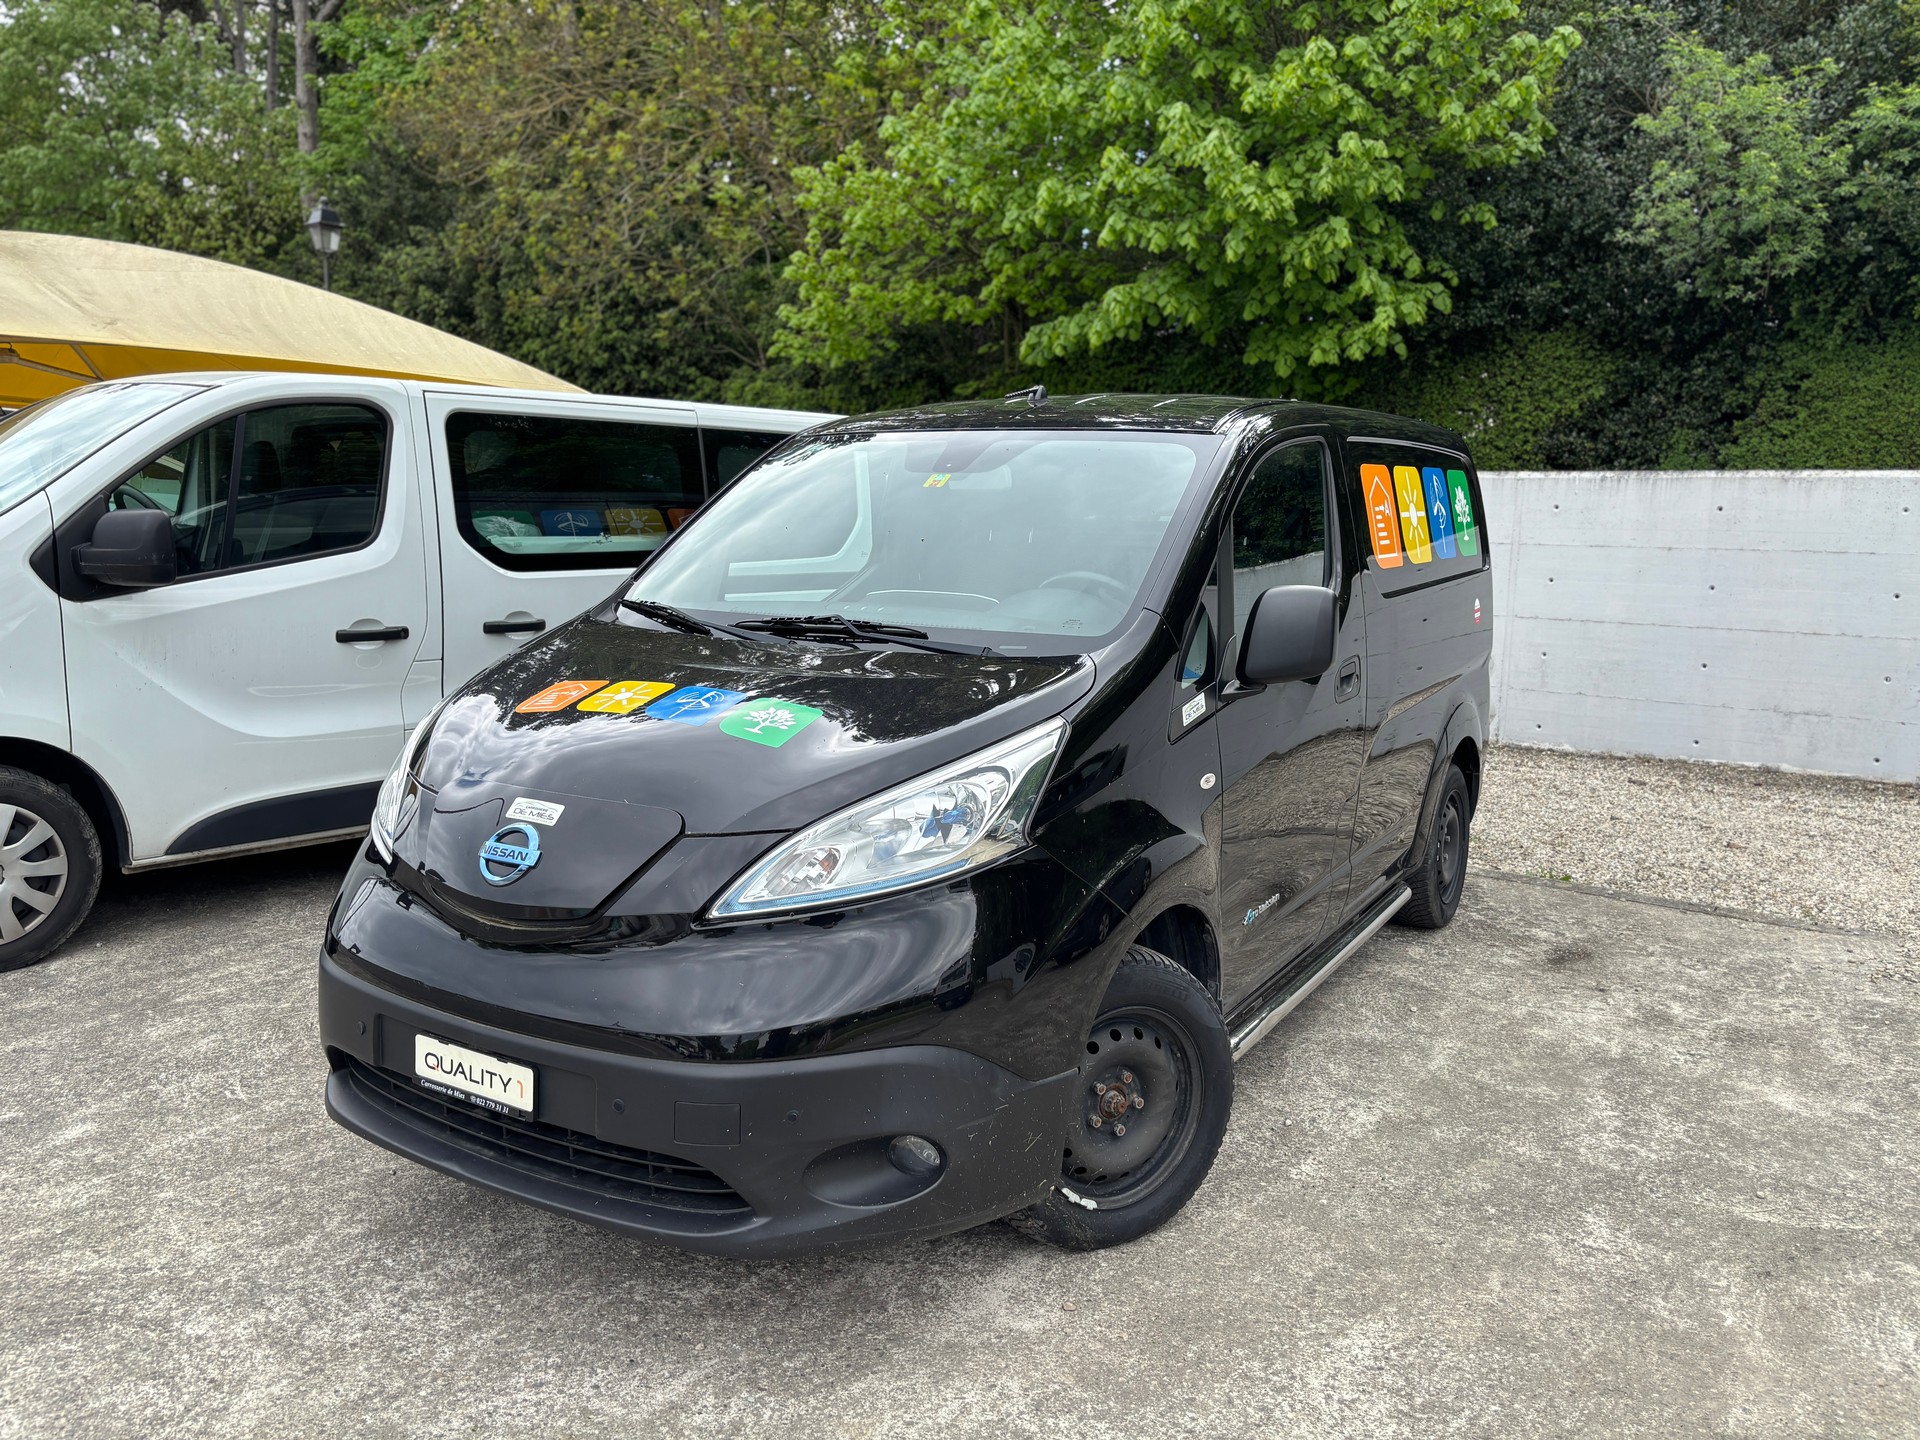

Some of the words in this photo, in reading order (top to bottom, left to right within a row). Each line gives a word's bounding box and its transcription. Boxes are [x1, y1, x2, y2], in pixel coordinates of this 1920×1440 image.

[513, 807, 527, 816] DE
[528, 810, 555, 821] MIES
[482, 844, 529, 862] NISSAN
[424, 1052, 512, 1094] QUALITY
[516, 1079, 524, 1099] 1
[420, 1079, 447, 1093] Carrosserie
[454, 1089, 466, 1100] Mies
[476, 1097, 485, 1107] 022
[486, 1100, 496, 1109] 779
[495, 1103, 502, 1112] 31
[502, 1106, 509, 1114] 31
